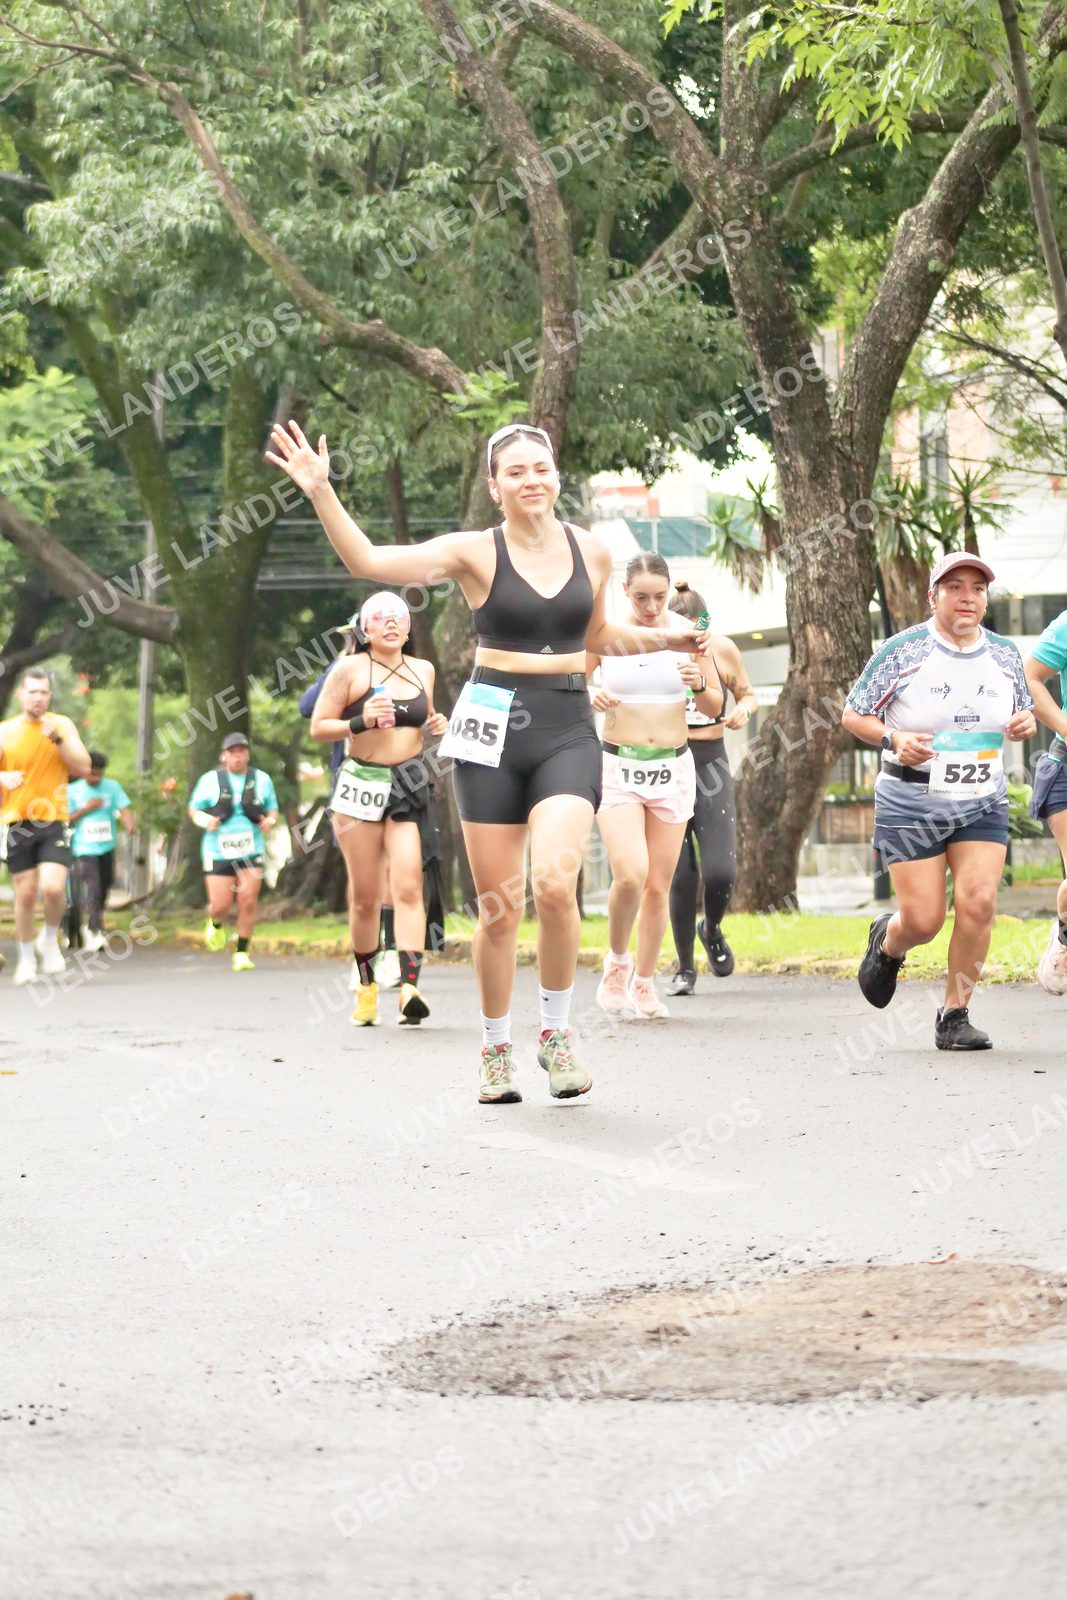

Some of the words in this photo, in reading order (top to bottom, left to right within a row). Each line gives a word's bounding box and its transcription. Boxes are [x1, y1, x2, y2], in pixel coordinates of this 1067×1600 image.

[621, 768, 672, 786] 1979
[944, 763, 991, 784] 523
[340, 784, 385, 808] 2100
